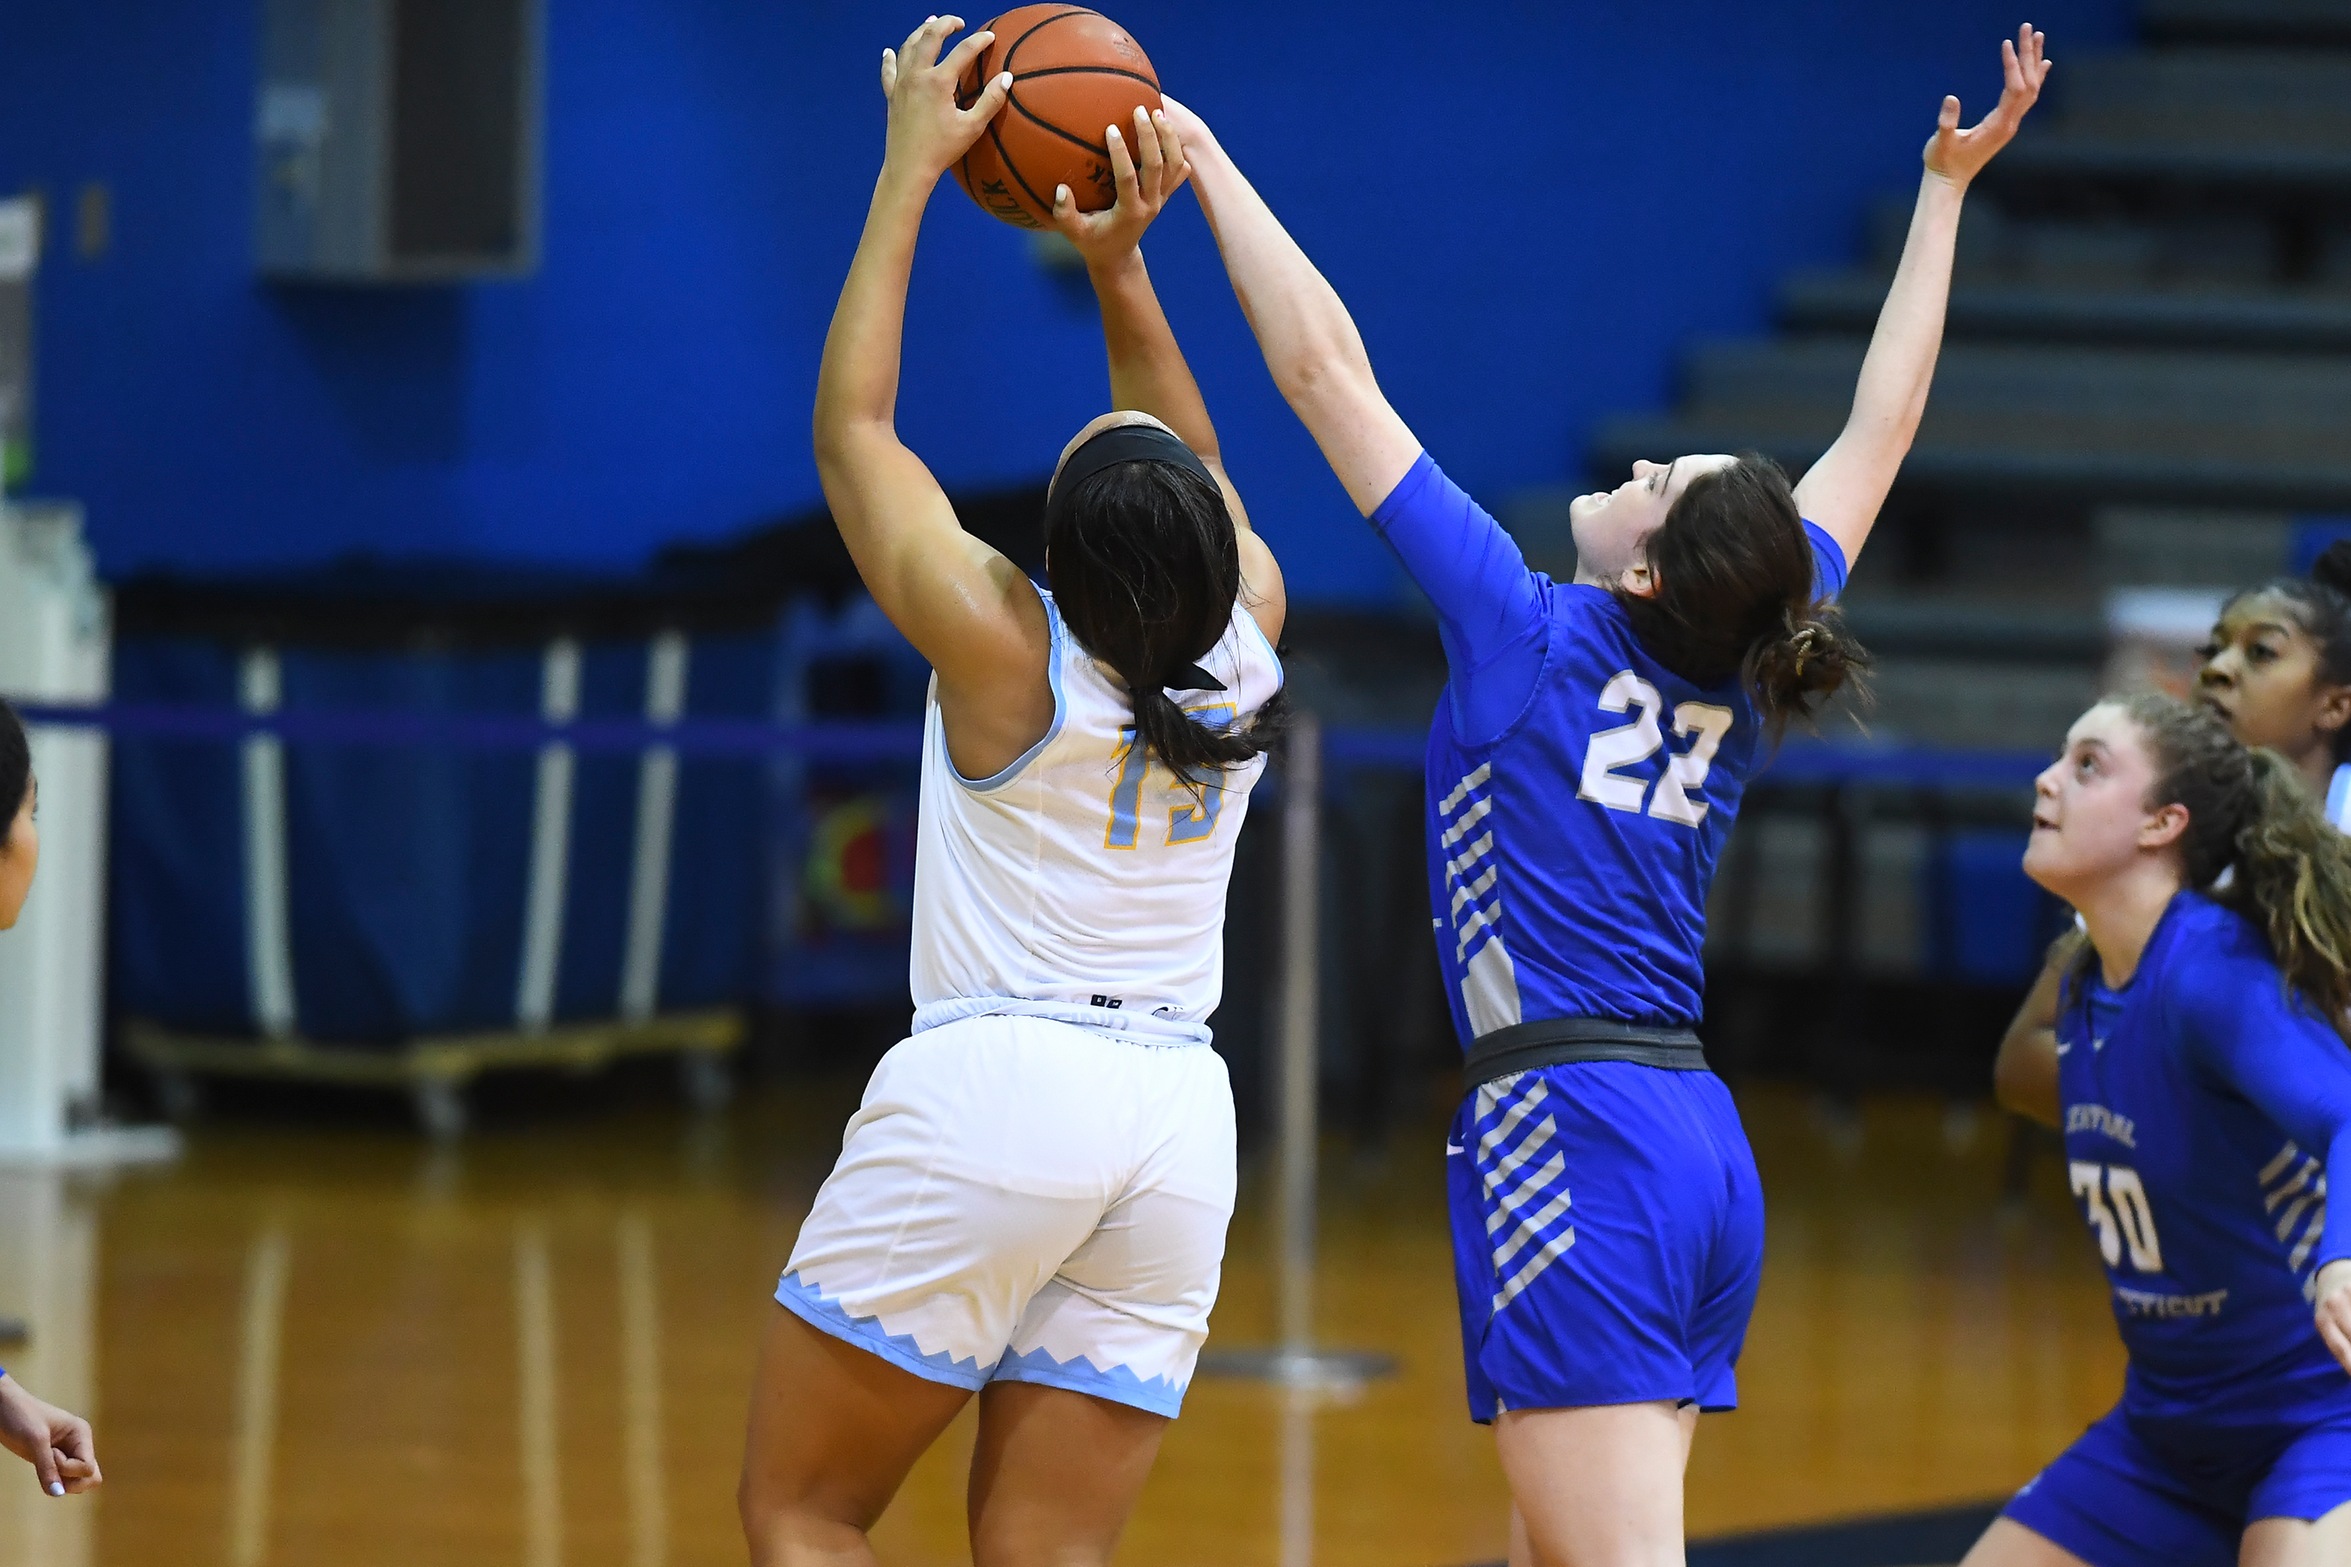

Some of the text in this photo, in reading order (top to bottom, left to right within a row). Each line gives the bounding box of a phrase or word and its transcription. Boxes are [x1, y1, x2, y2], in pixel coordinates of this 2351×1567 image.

[1103, 701, 1238, 851] 15
[1575, 668, 1734, 829] 22
[2068, 1160, 2164, 1273] 30
